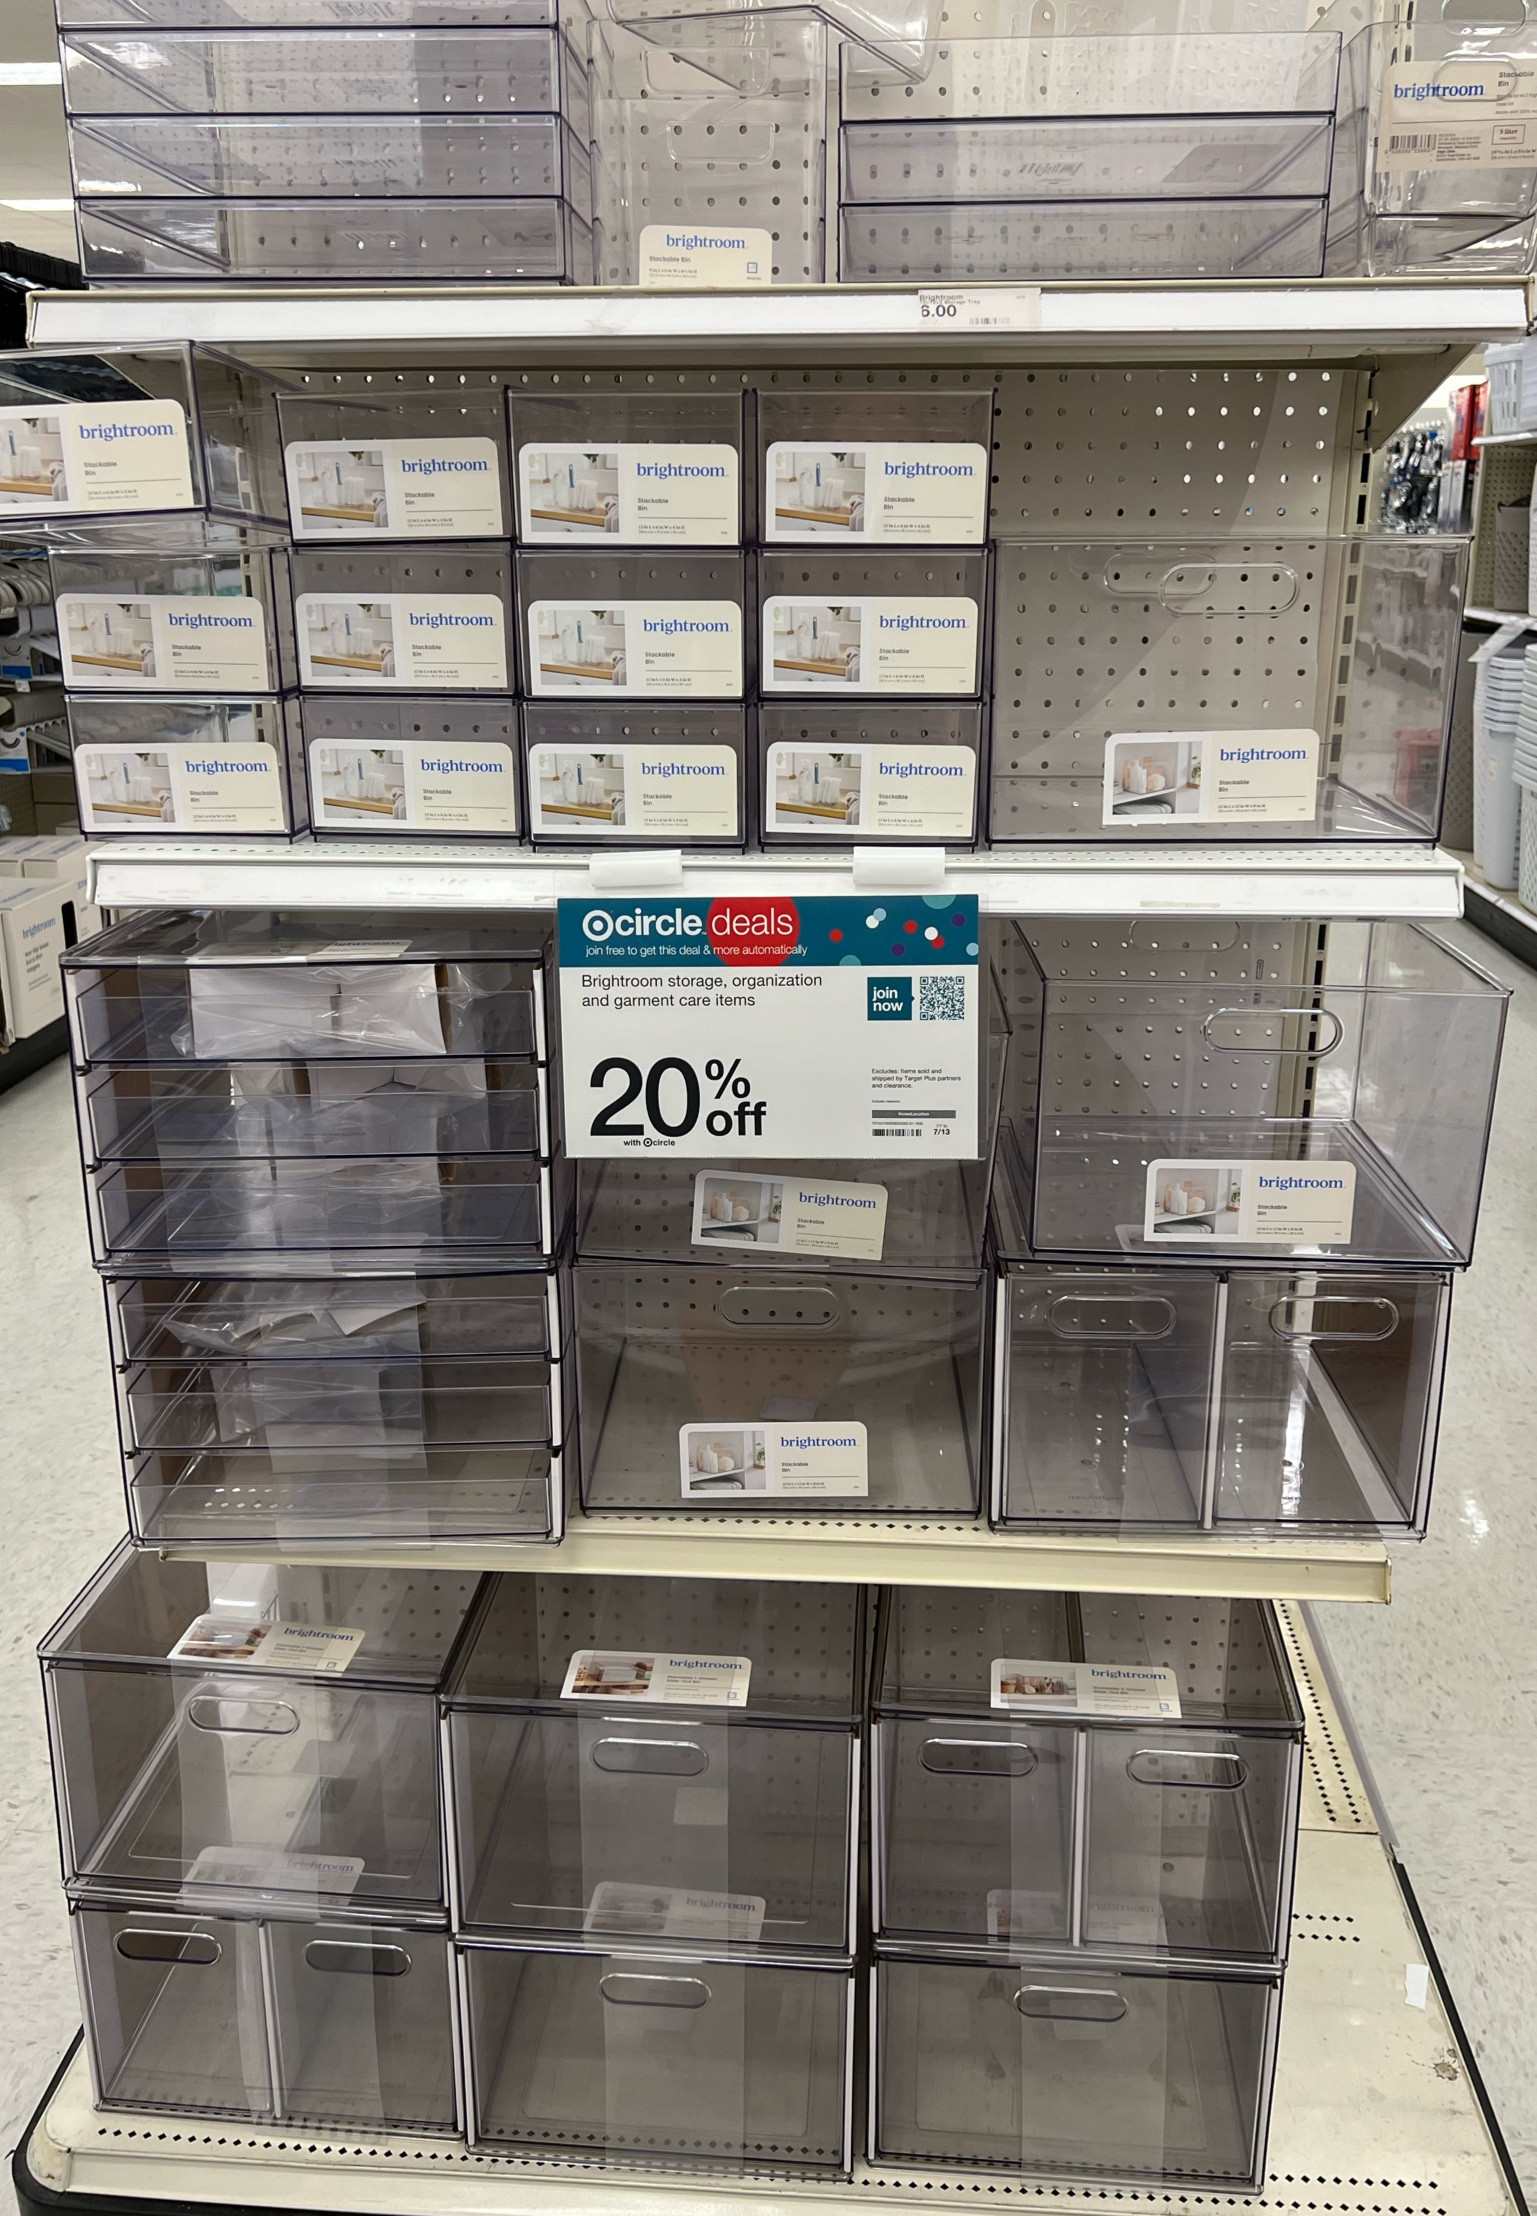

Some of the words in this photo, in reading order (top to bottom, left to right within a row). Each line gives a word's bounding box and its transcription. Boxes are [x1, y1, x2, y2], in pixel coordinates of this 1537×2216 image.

[1394, 83, 1484, 101] brightroom
[666, 234, 746, 250] brightroom
[921, 304, 957, 317] 6.00
[79, 422, 173, 442] brightroom
[401, 458, 488, 475] brightroom
[637, 462, 725, 479] brightroom
[884, 461, 973, 478] brightroom
[168, 612, 253, 629] brightroom
[409, 612, 494, 628] brightroom
[643, 618, 729, 635] brightroom
[879, 615, 966, 631] brightroom
[1220, 748, 1306, 764] brightroom
[185, 760, 268, 775] brightroom
[420, 758, 503, 774] brightroom
[642, 762, 725, 778] brightroom
[879, 762, 963, 778] brightroom
[615, 908, 703, 936] circle
[711, 907, 793, 936] deals
[585, 945, 603, 958] join
[606, 945, 625, 955] free
[627, 946, 637, 955] to
[640, 946, 656, 957] get
[659, 945, 676, 955] this
[679, 945, 700, 955] deal
[703, 945, 711, 955] &
[714, 947, 740, 955] more
[742, 944, 808, 956] automatically
[582, 974, 664, 991] Brightroom
[667, 975, 728, 991] storage,
[732, 973, 822, 989] organization
[872, 987, 898, 1001] join
[582, 994, 609, 1007] and
[613, 995, 674, 1011] garment
[679, 996, 711, 1007] care
[715, 994, 756, 1007] items
[873, 1000, 904, 1012] now
[590, 1057, 701, 1137] 20
[705, 1058, 751, 1099] %
[706, 1101, 767, 1136] off
[1259, 1176, 1343, 1190] brightroom
[799, 1192, 876, 1208] brightroom
[781, 1436, 856, 1449] brightroom
[284, 1627, 354, 1641] brightroom
[669, 1659, 743, 1670] brightroom
[1091, 1668, 1167, 1680] brightroom
